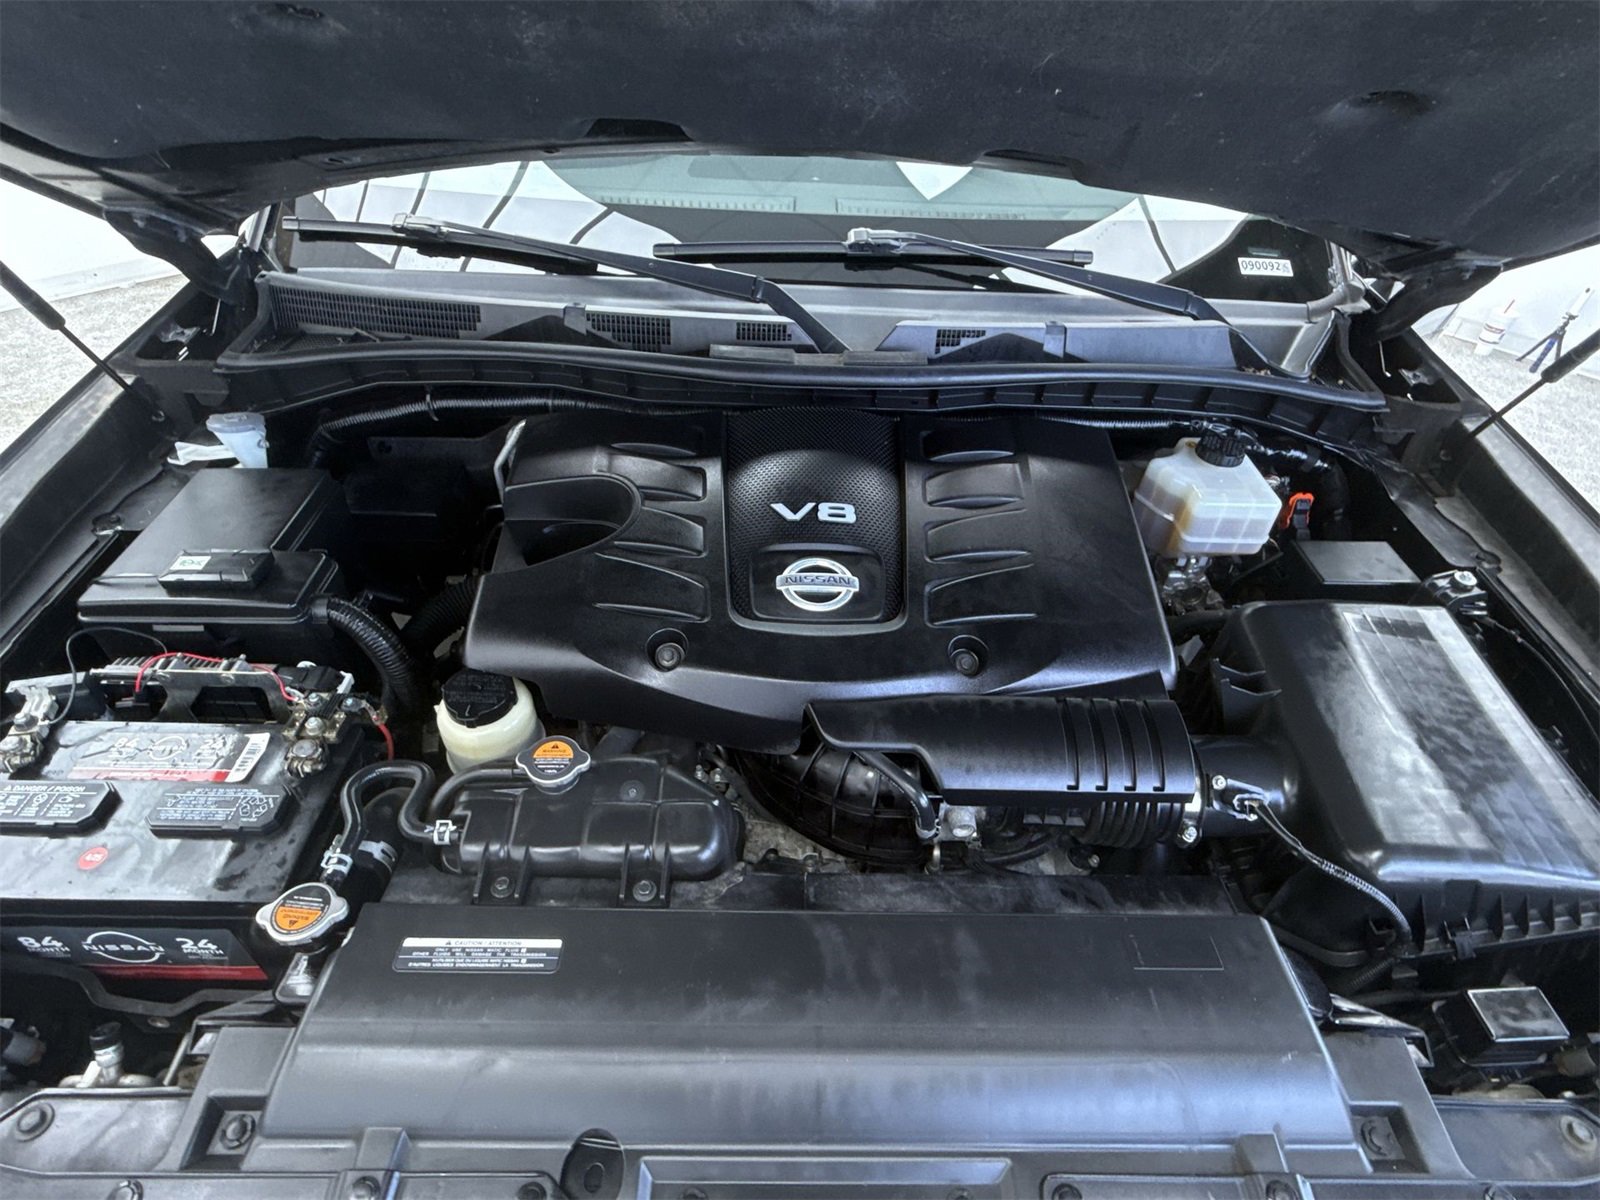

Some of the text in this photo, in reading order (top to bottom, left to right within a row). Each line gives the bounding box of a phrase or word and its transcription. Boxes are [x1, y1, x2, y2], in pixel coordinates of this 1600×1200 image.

[769, 502, 857, 524] V8
[784, 575, 851, 586] NISSAN
[17, 936, 64, 948] 84
[82, 943, 165, 952] NISSAN
[175, 937, 218, 950] 24
